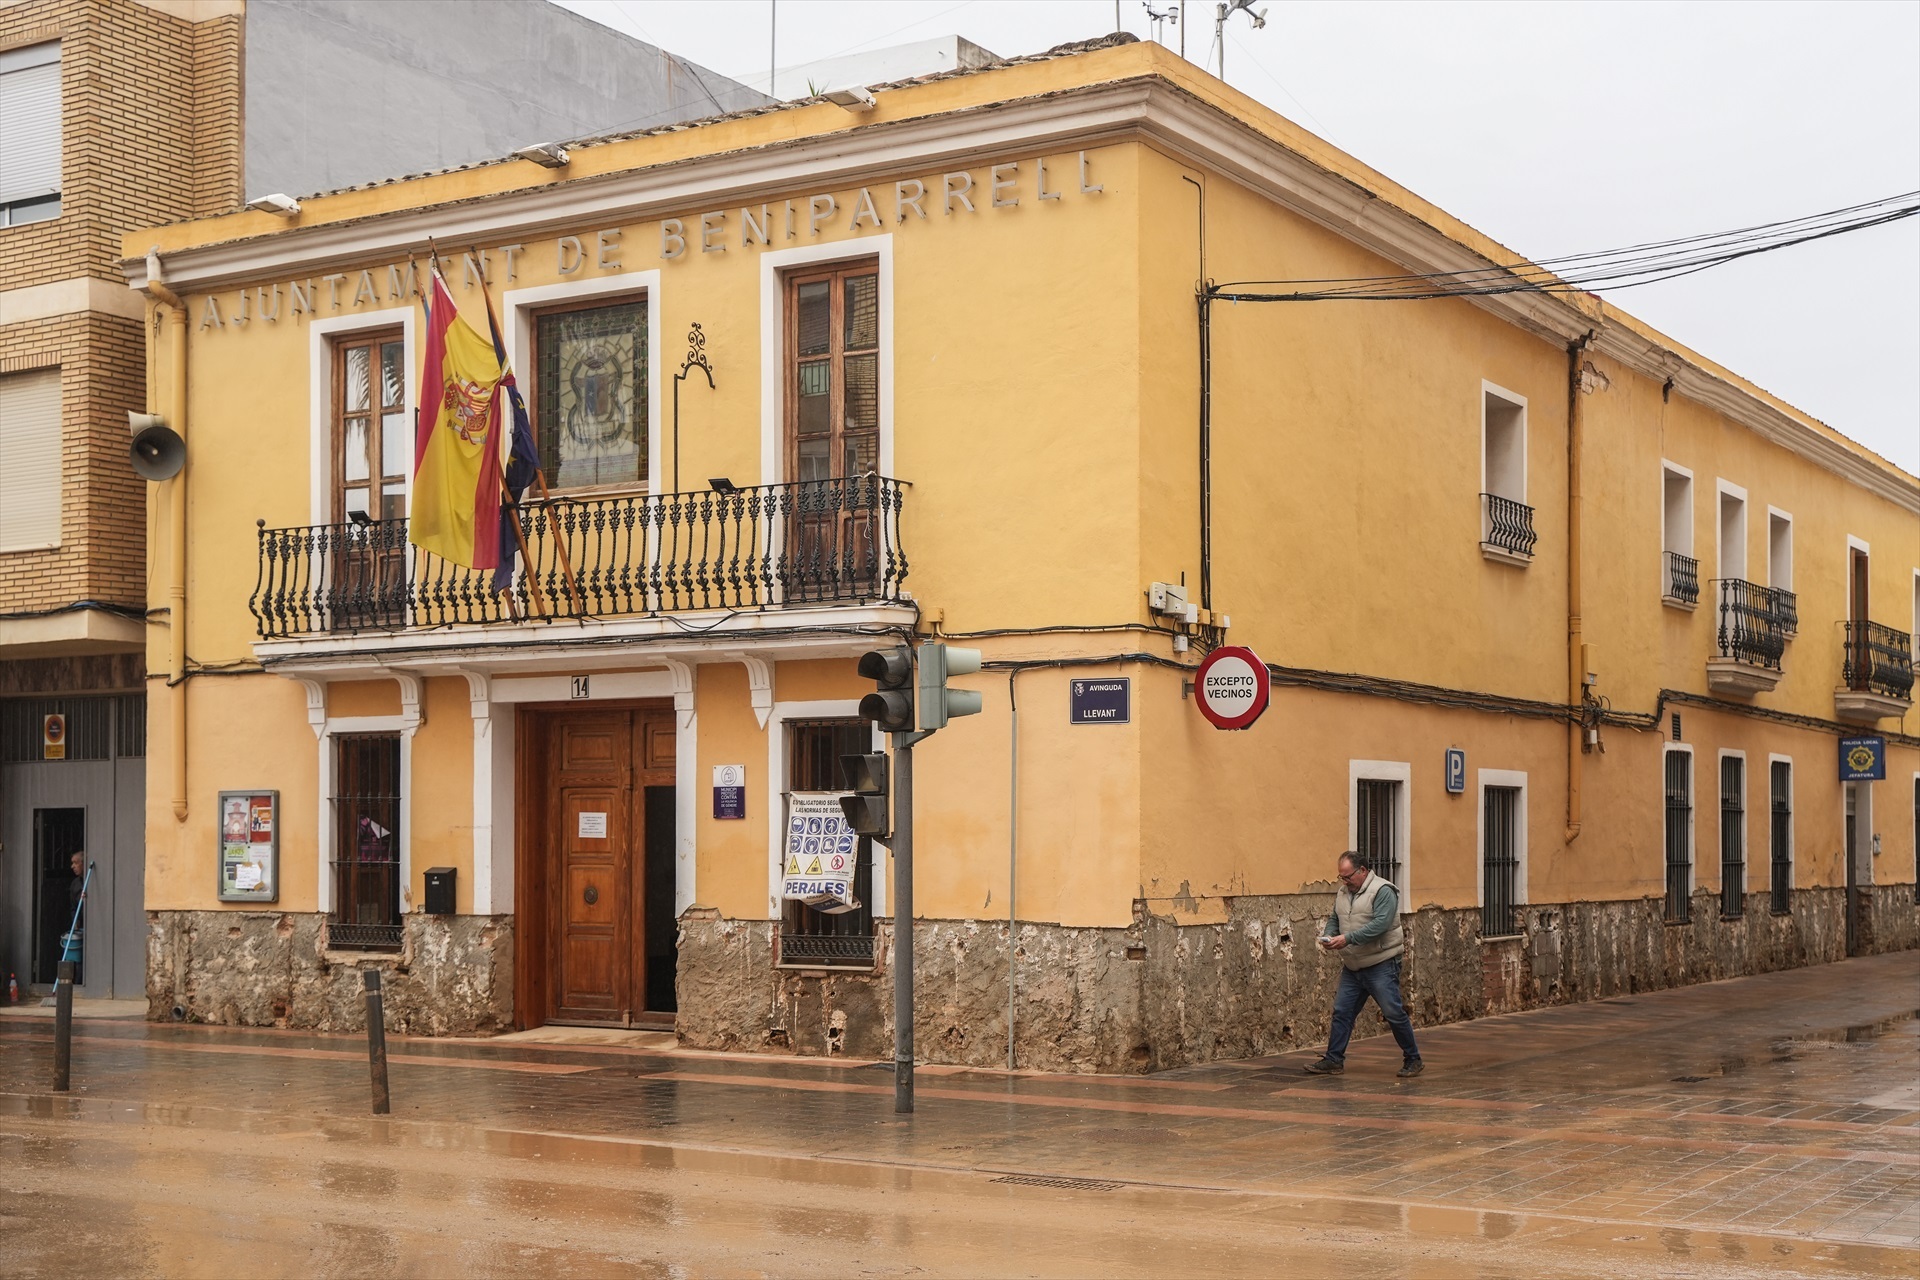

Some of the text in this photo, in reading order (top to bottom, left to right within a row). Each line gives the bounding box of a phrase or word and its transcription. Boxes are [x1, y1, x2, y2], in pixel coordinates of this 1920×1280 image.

[199, 150, 1104, 331] AJUNTAMENT DE BENIPARRELL
[573, 677, 588, 696] 14
[1206, 676, 1254, 686] EXCEPTO
[1208, 689, 1252, 698] VECINOS
[1083, 709, 1116, 718] LLEVANT
[1451, 753, 1462, 787] P
[785, 882, 845, 895] PERALES
